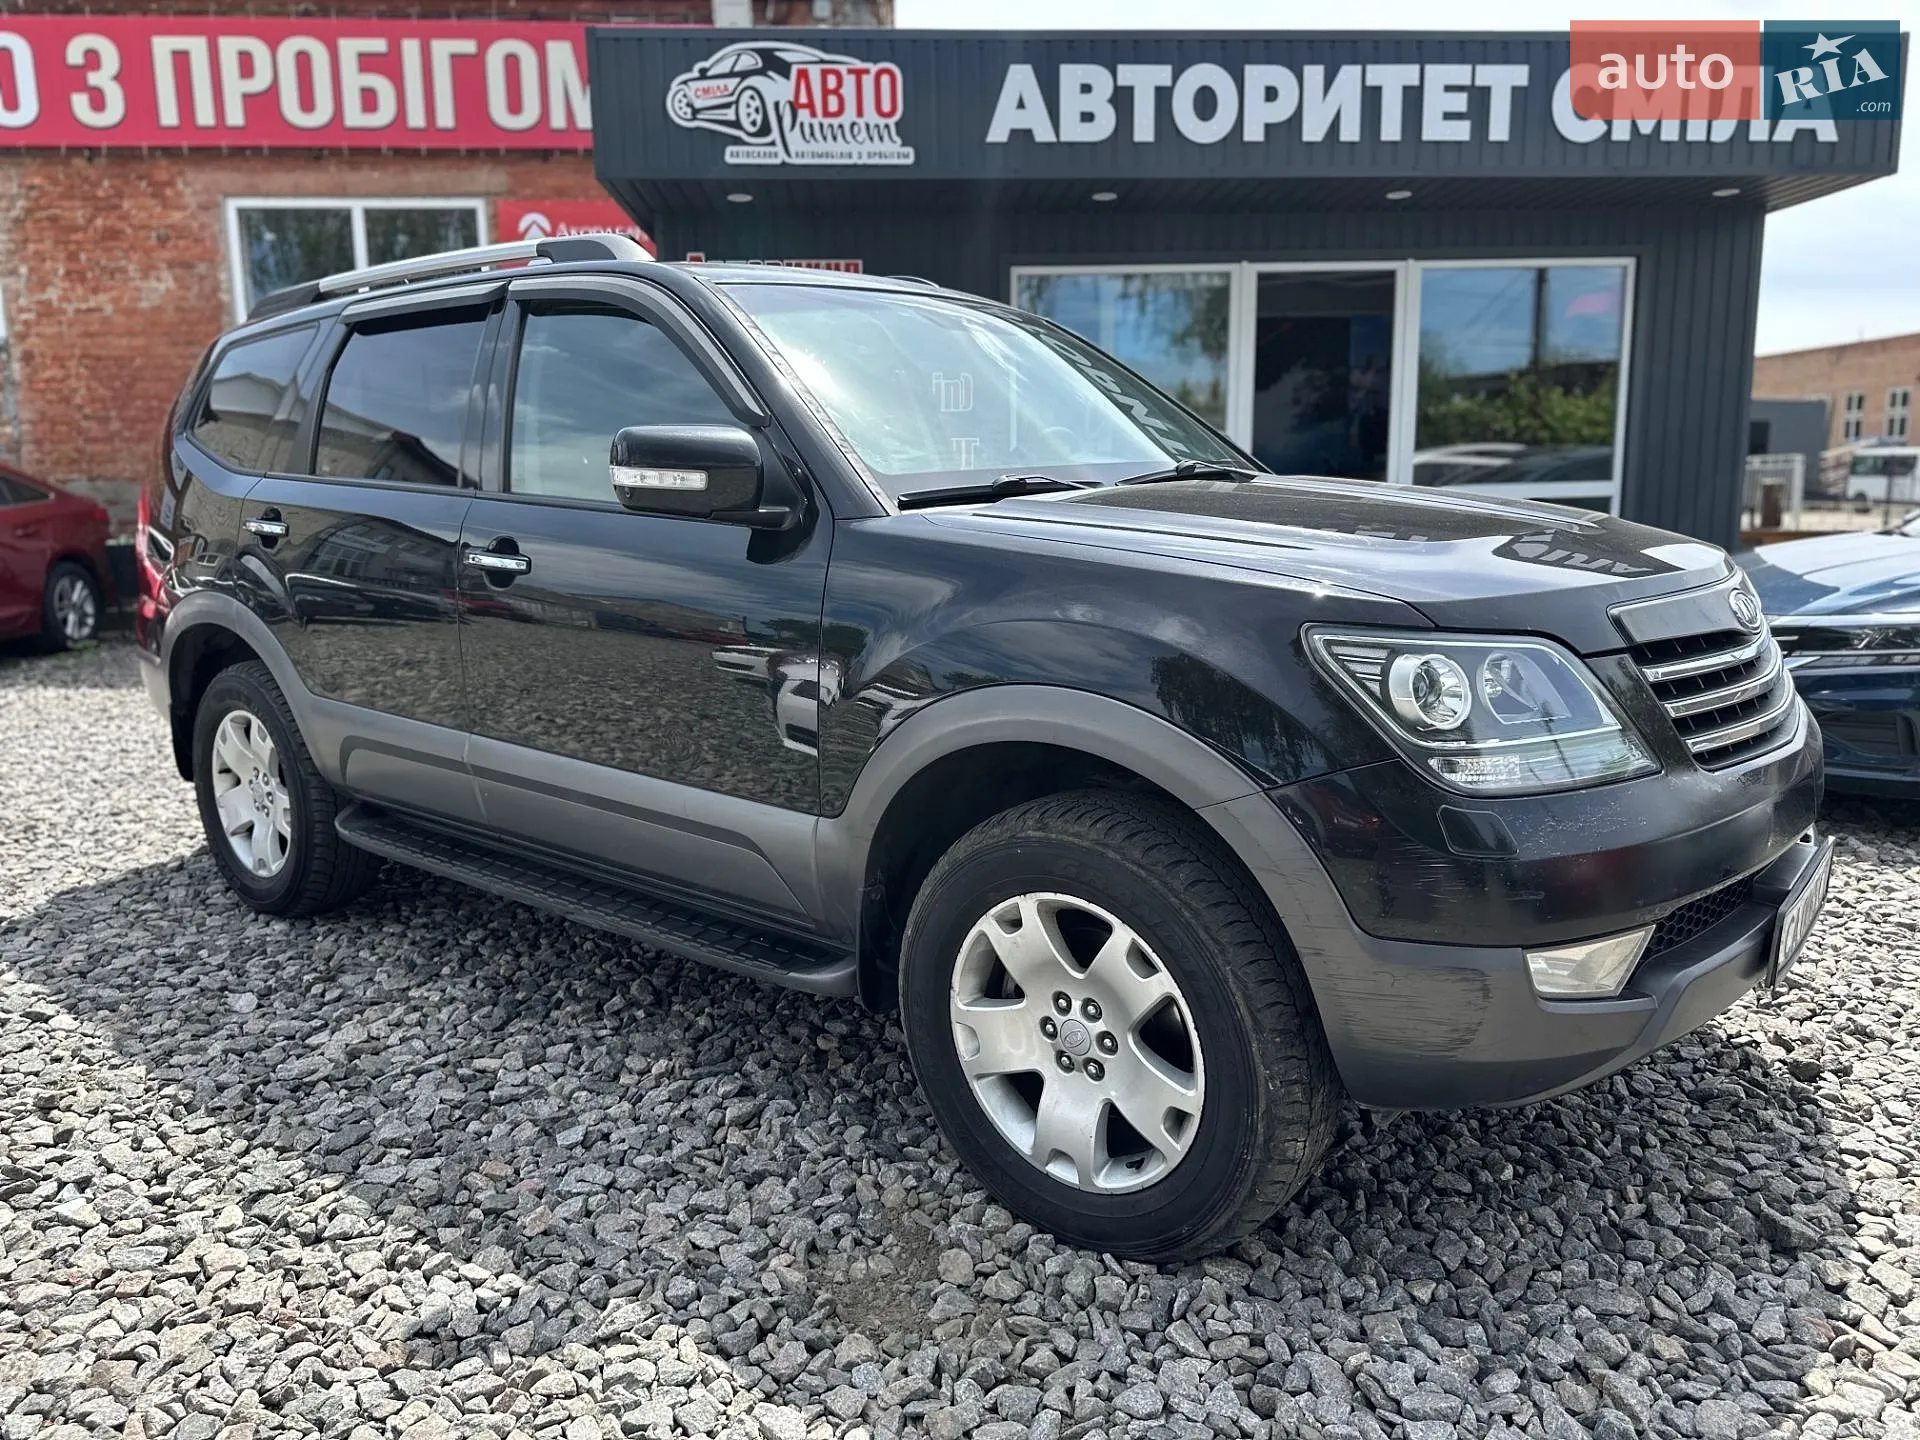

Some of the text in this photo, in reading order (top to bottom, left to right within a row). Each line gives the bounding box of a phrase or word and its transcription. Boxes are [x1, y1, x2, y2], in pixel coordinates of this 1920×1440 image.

[65, 32, 126, 130] З
[792, 67, 898, 119] АВТО
[985, 62, 1839, 144] АВТОРИТЕТ СМІЛА
